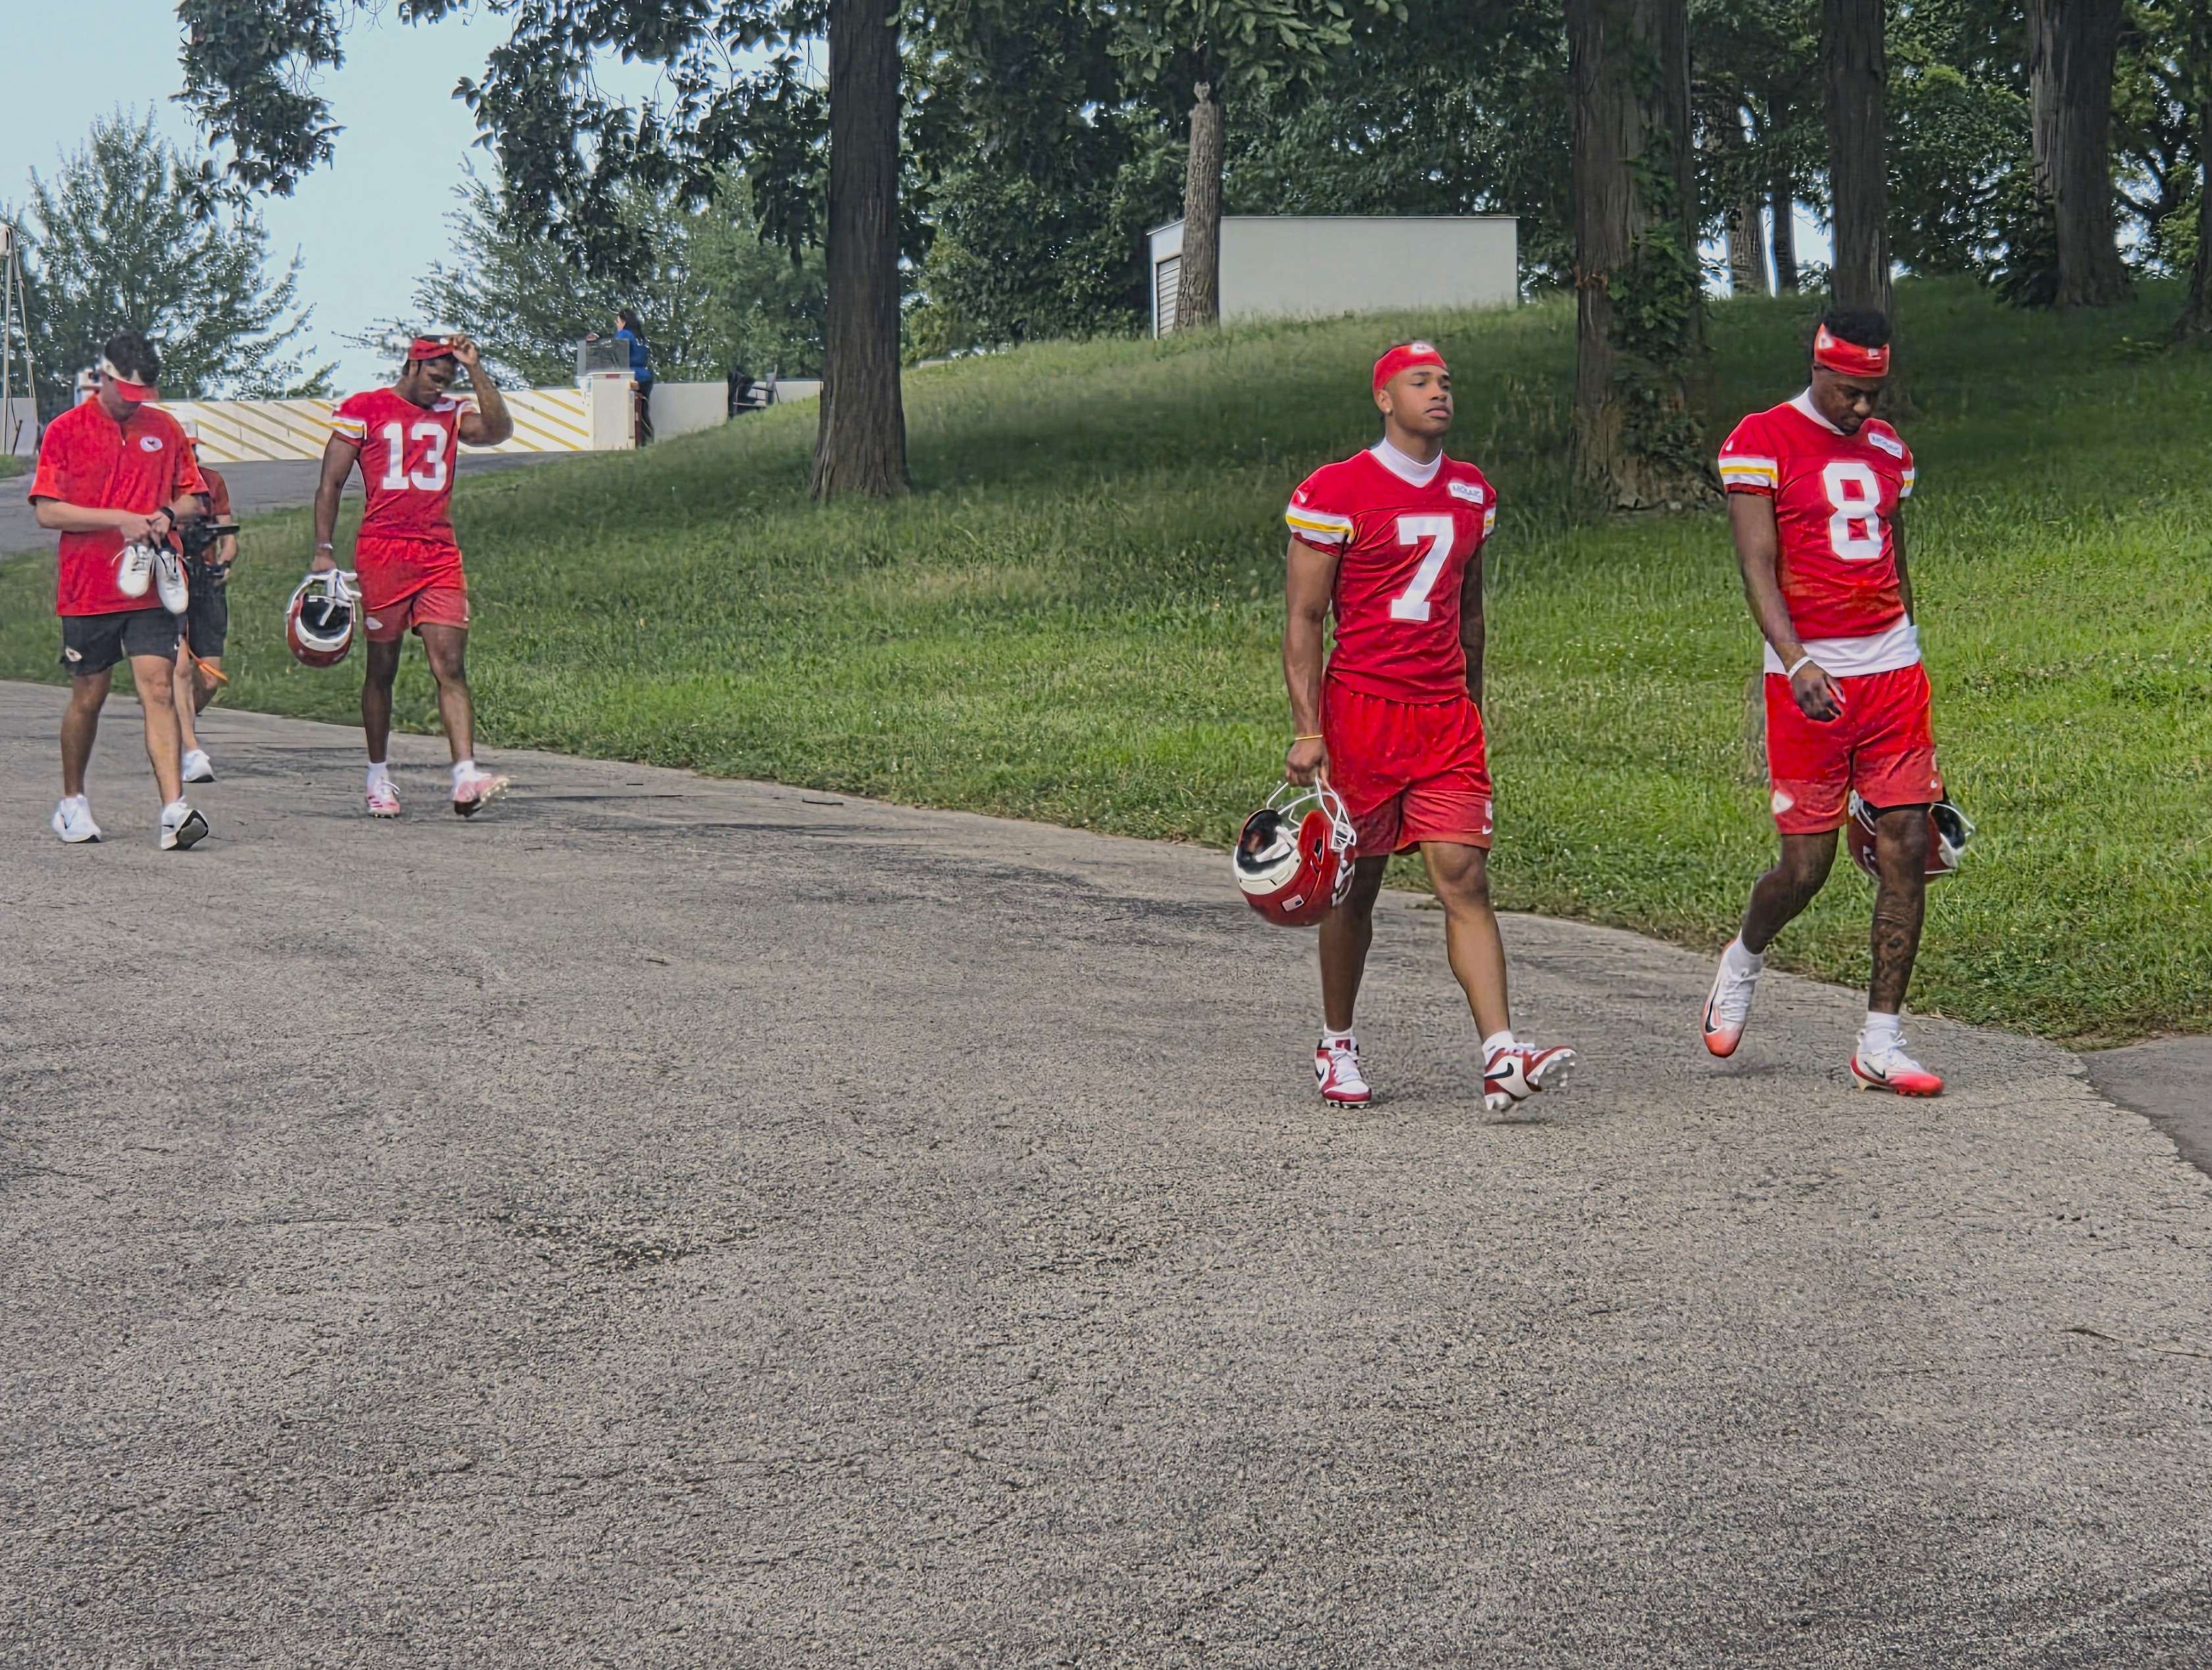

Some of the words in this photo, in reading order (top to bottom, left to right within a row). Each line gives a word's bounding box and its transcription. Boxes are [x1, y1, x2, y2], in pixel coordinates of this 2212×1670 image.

[382, 423, 447, 491] 13
[1822, 462, 1882, 560] 8
[1390, 516, 1454, 621] 7
